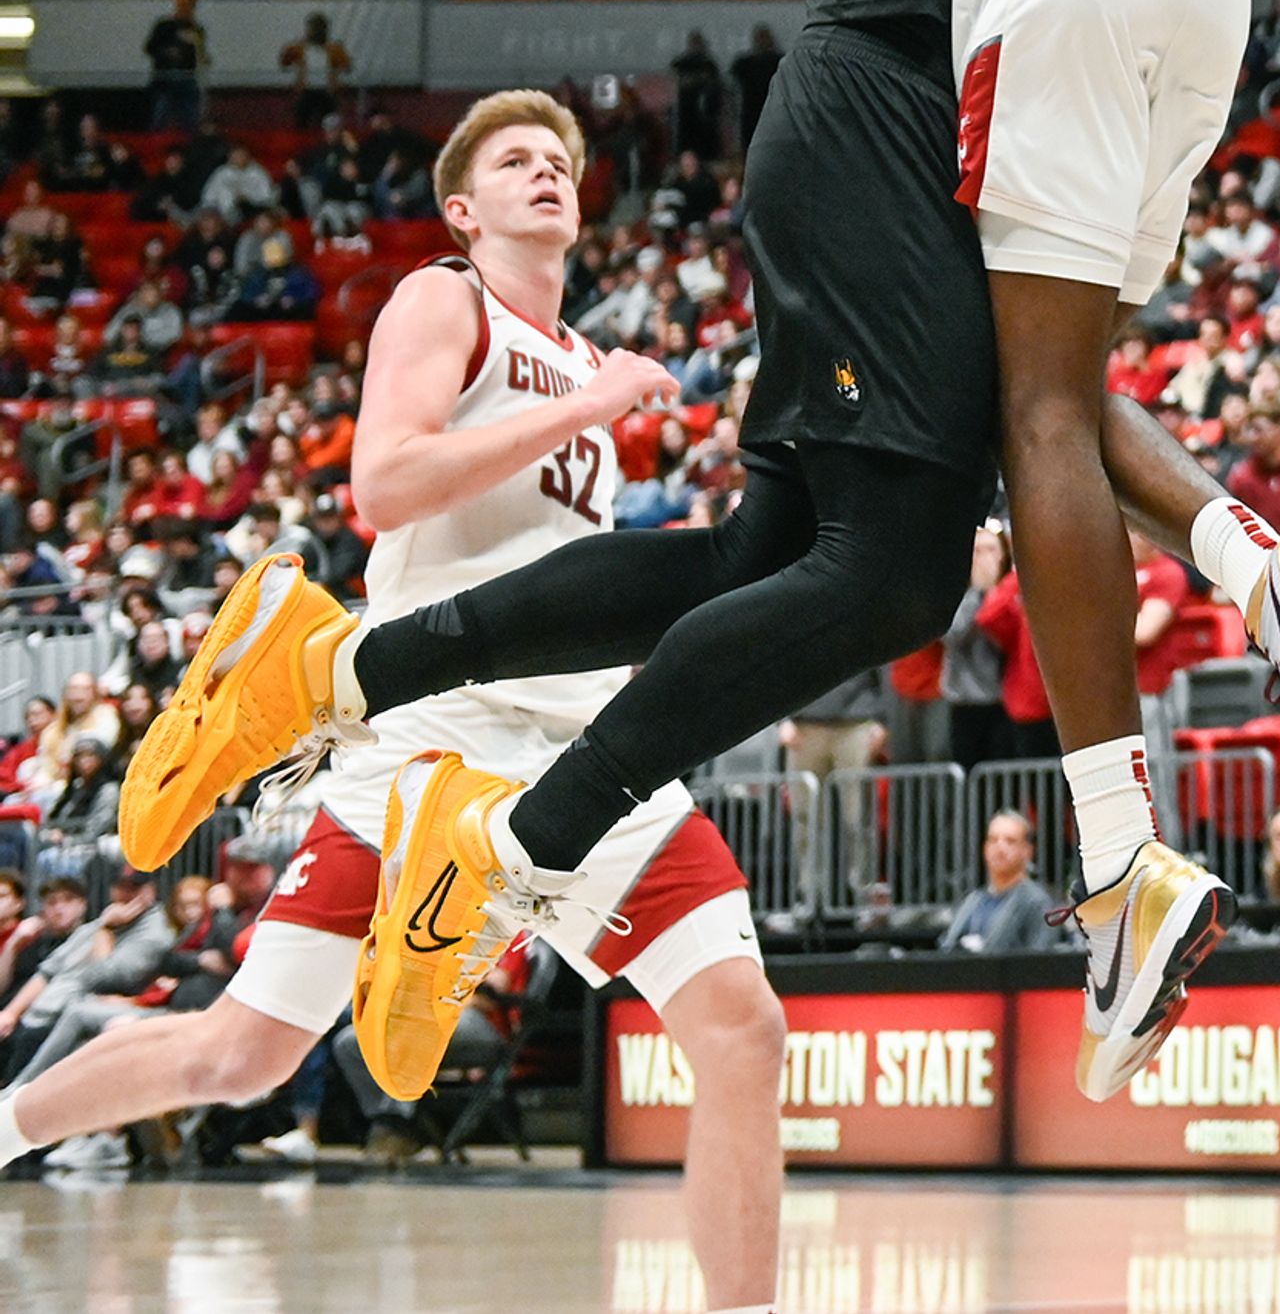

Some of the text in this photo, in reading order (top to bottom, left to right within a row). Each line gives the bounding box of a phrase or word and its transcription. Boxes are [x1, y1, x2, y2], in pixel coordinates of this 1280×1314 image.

[540, 433, 602, 527] 32
[617, 1030, 996, 1107] WASTON STATE
